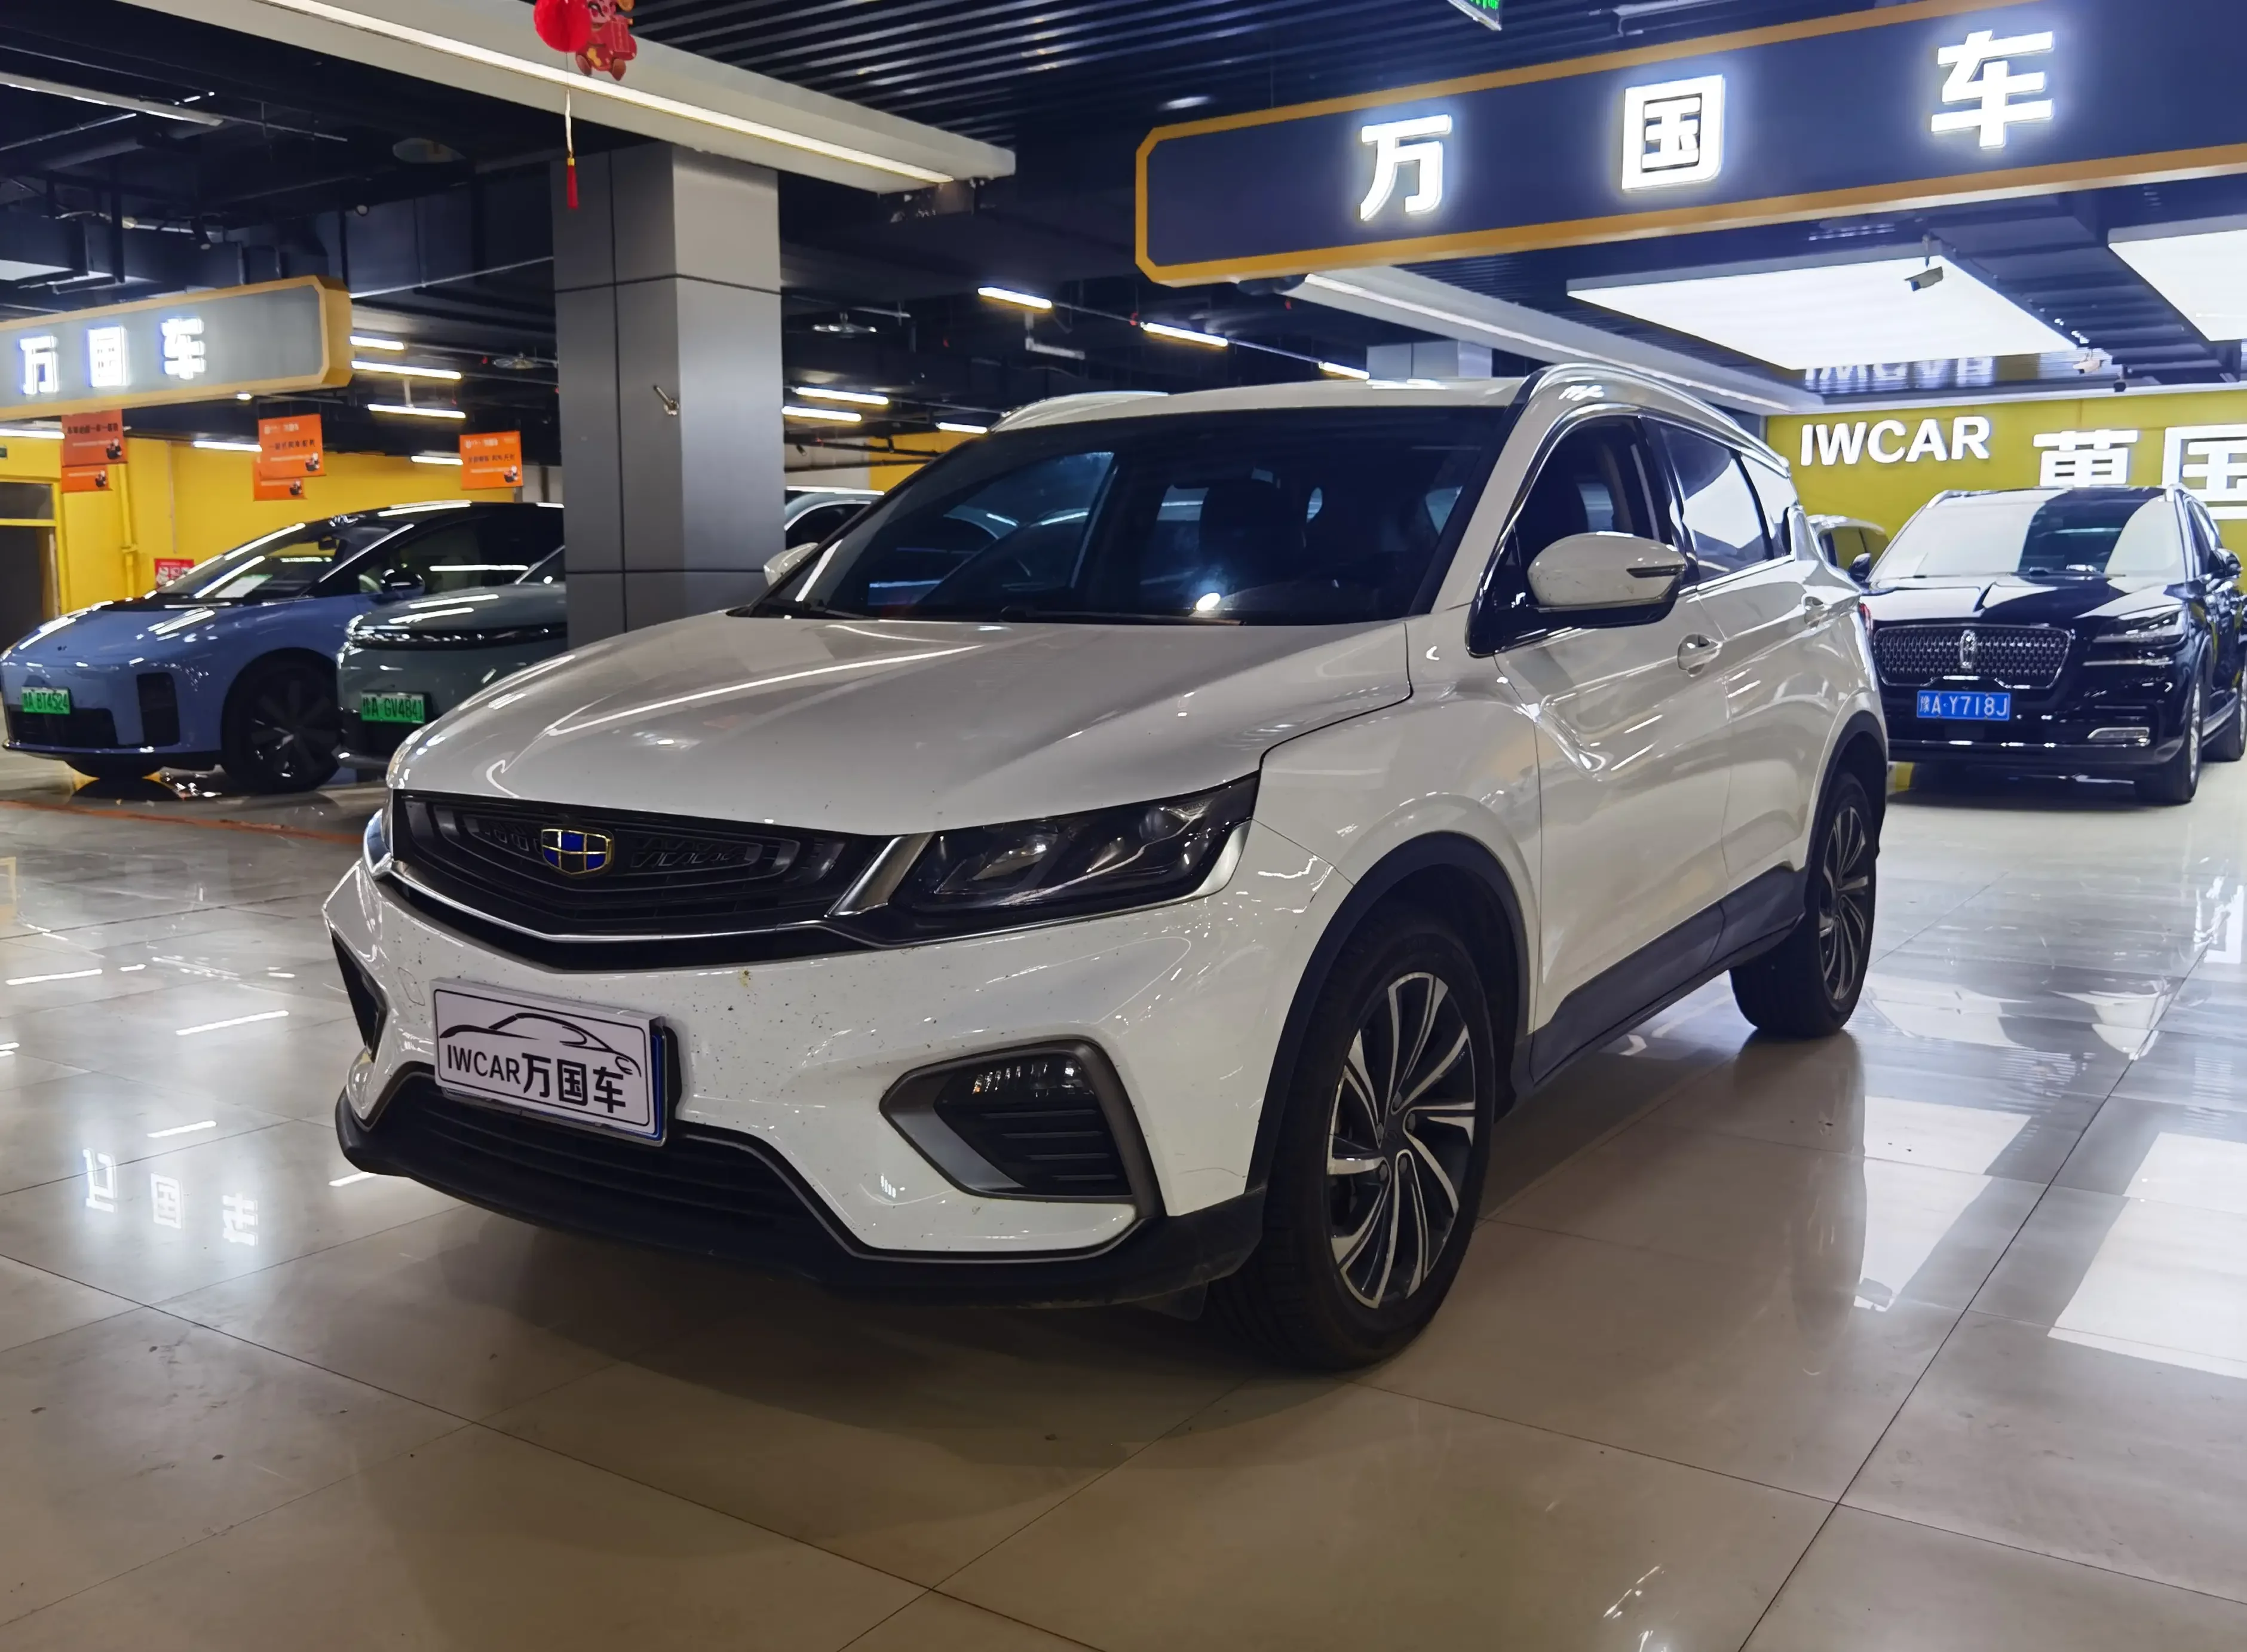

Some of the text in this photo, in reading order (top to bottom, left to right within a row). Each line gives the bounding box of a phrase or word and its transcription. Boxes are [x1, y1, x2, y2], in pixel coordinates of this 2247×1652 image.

[1360, 29, 2055, 222] 万国车
[19, 317, 206, 395] 万国车
[1800, 416, 1991, 467] IWCAR
